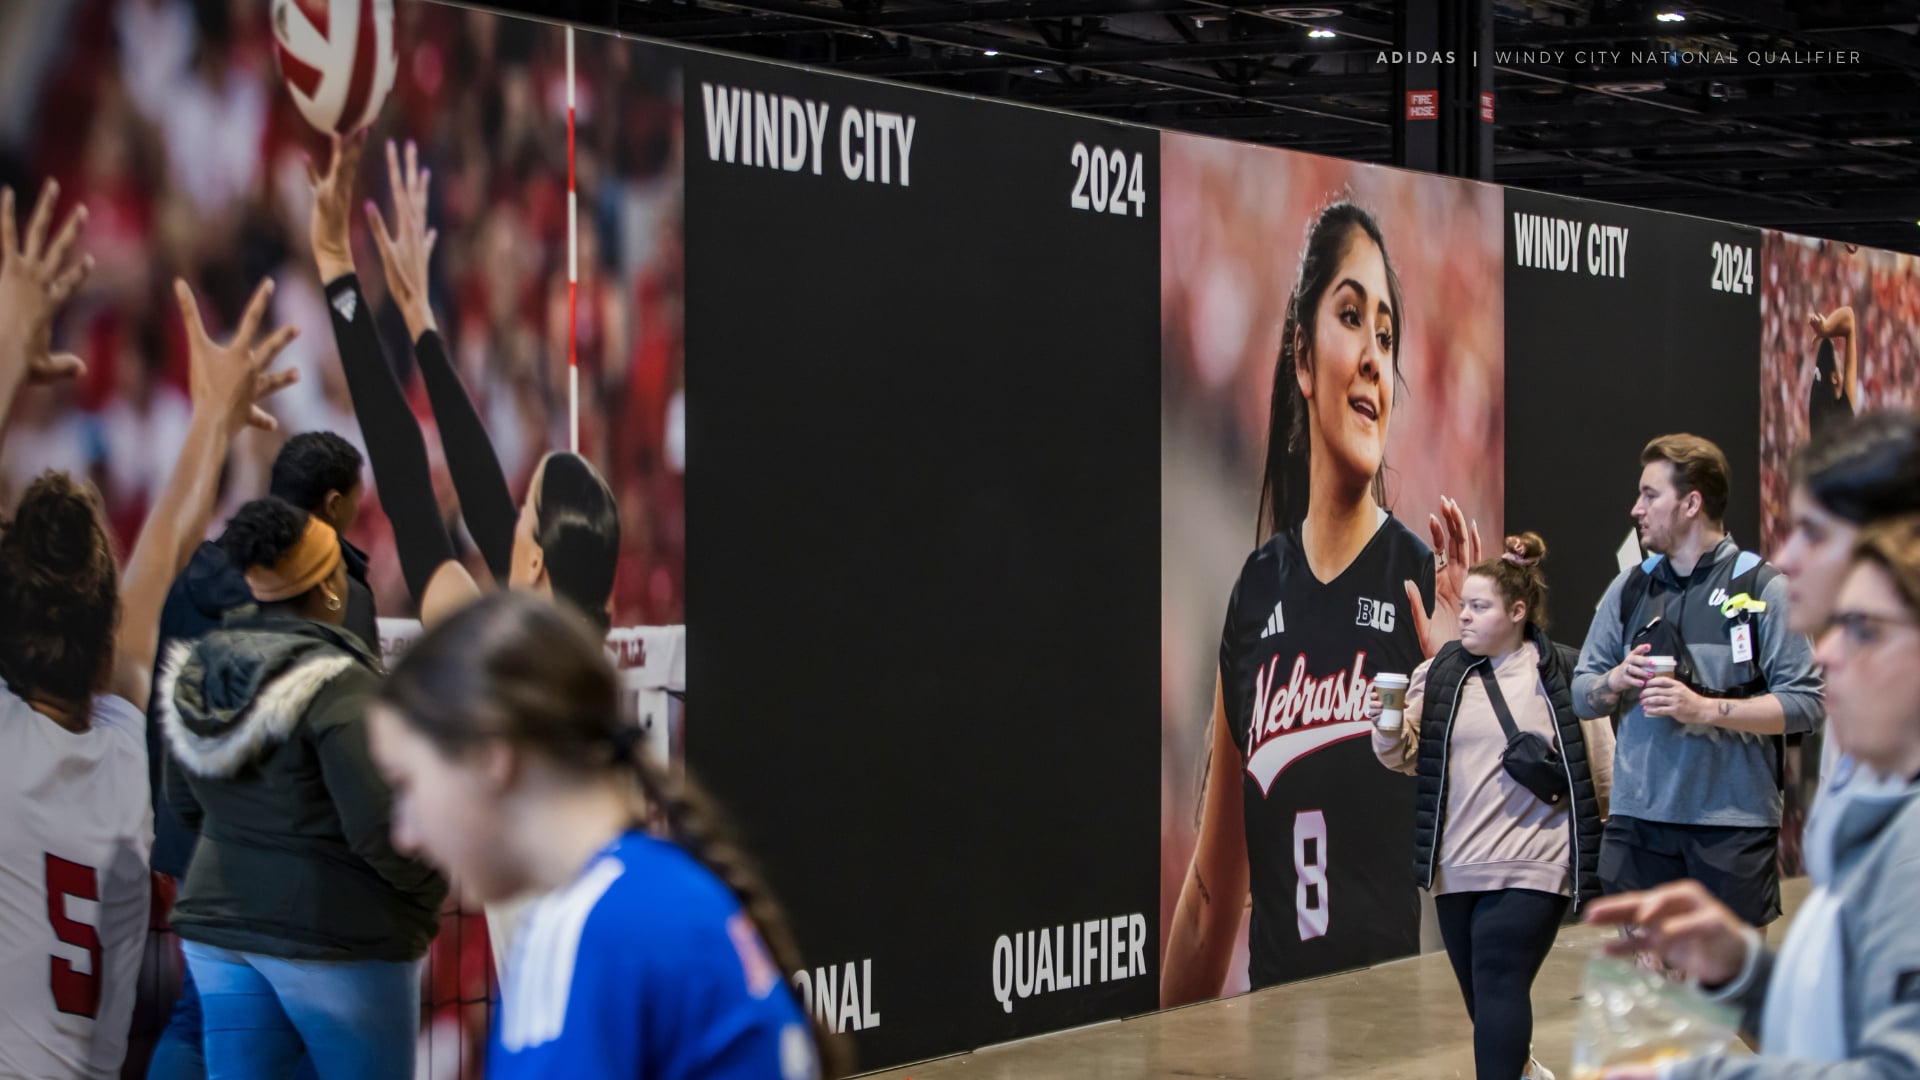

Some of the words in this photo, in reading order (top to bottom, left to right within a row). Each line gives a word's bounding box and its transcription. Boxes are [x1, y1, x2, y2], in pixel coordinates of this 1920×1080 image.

[702, 82, 829, 176] WINDY
[841, 105, 916, 187] CITY
[1410, 106, 1435, 117] HOSE
[1411, 94, 1433, 105] FIRE
[1071, 142, 1146, 218] 2024
[1514, 212, 1582, 273] WINDY
[1587, 223, 1629, 278] CITY
[1711, 241, 1754, 295] 2024
[1293, 810, 1329, 941] 8
[45, 852, 103, 1020] 5
[792, 958, 881, 1035] ONAL
[992, 912, 1147, 1014] QUALIFIER
